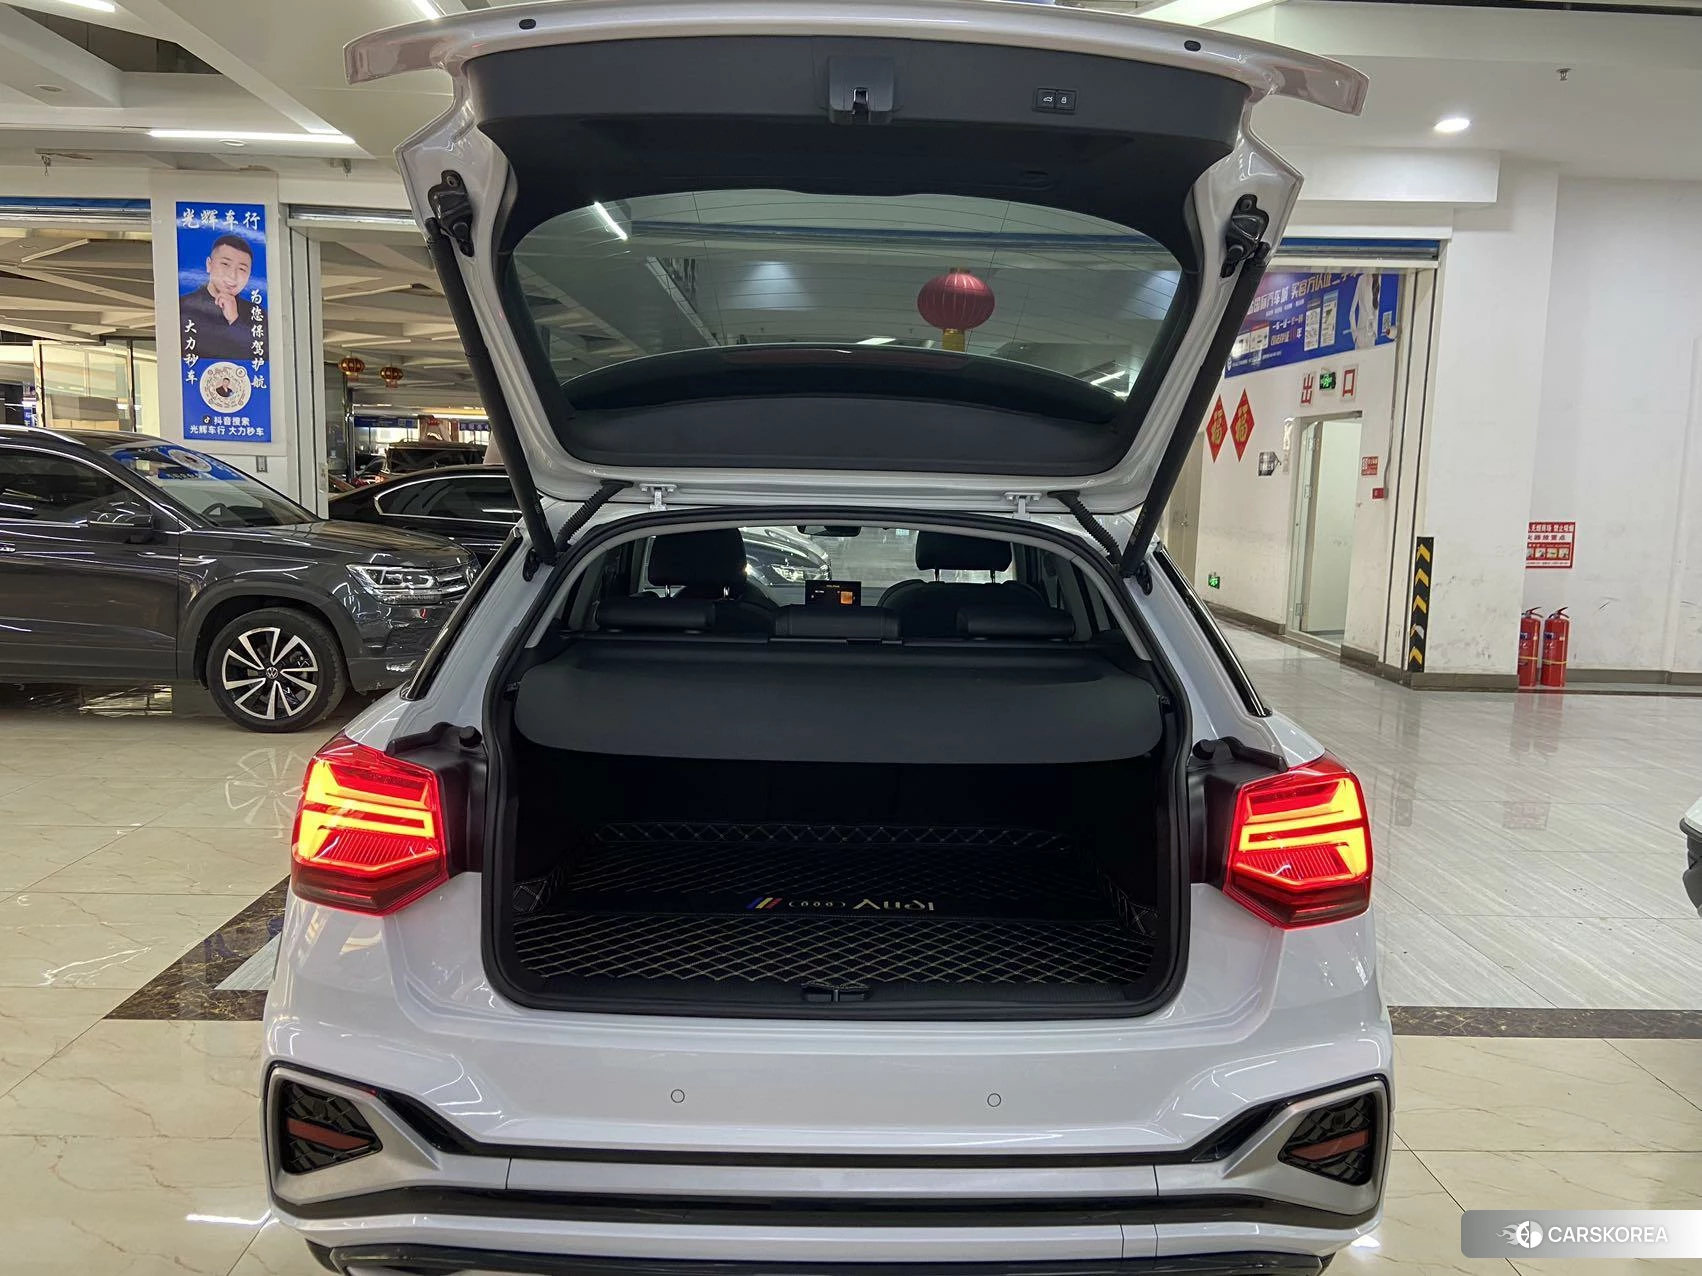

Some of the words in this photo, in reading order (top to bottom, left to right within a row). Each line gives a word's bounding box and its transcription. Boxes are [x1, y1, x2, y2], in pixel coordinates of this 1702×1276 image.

[181, 208, 261, 231] 光辉车行
[183, 319, 199, 385] 大力秒车
[250, 289, 267, 389] 为您保驾护航
[189, 425, 226, 435] 光辉车行
[228, 426, 265, 437] 大力秒车
[213, 416, 250, 427] 抖音搜索
[1211, 409, 1223, 445] 福
[1235, 405, 1249, 441] 福
